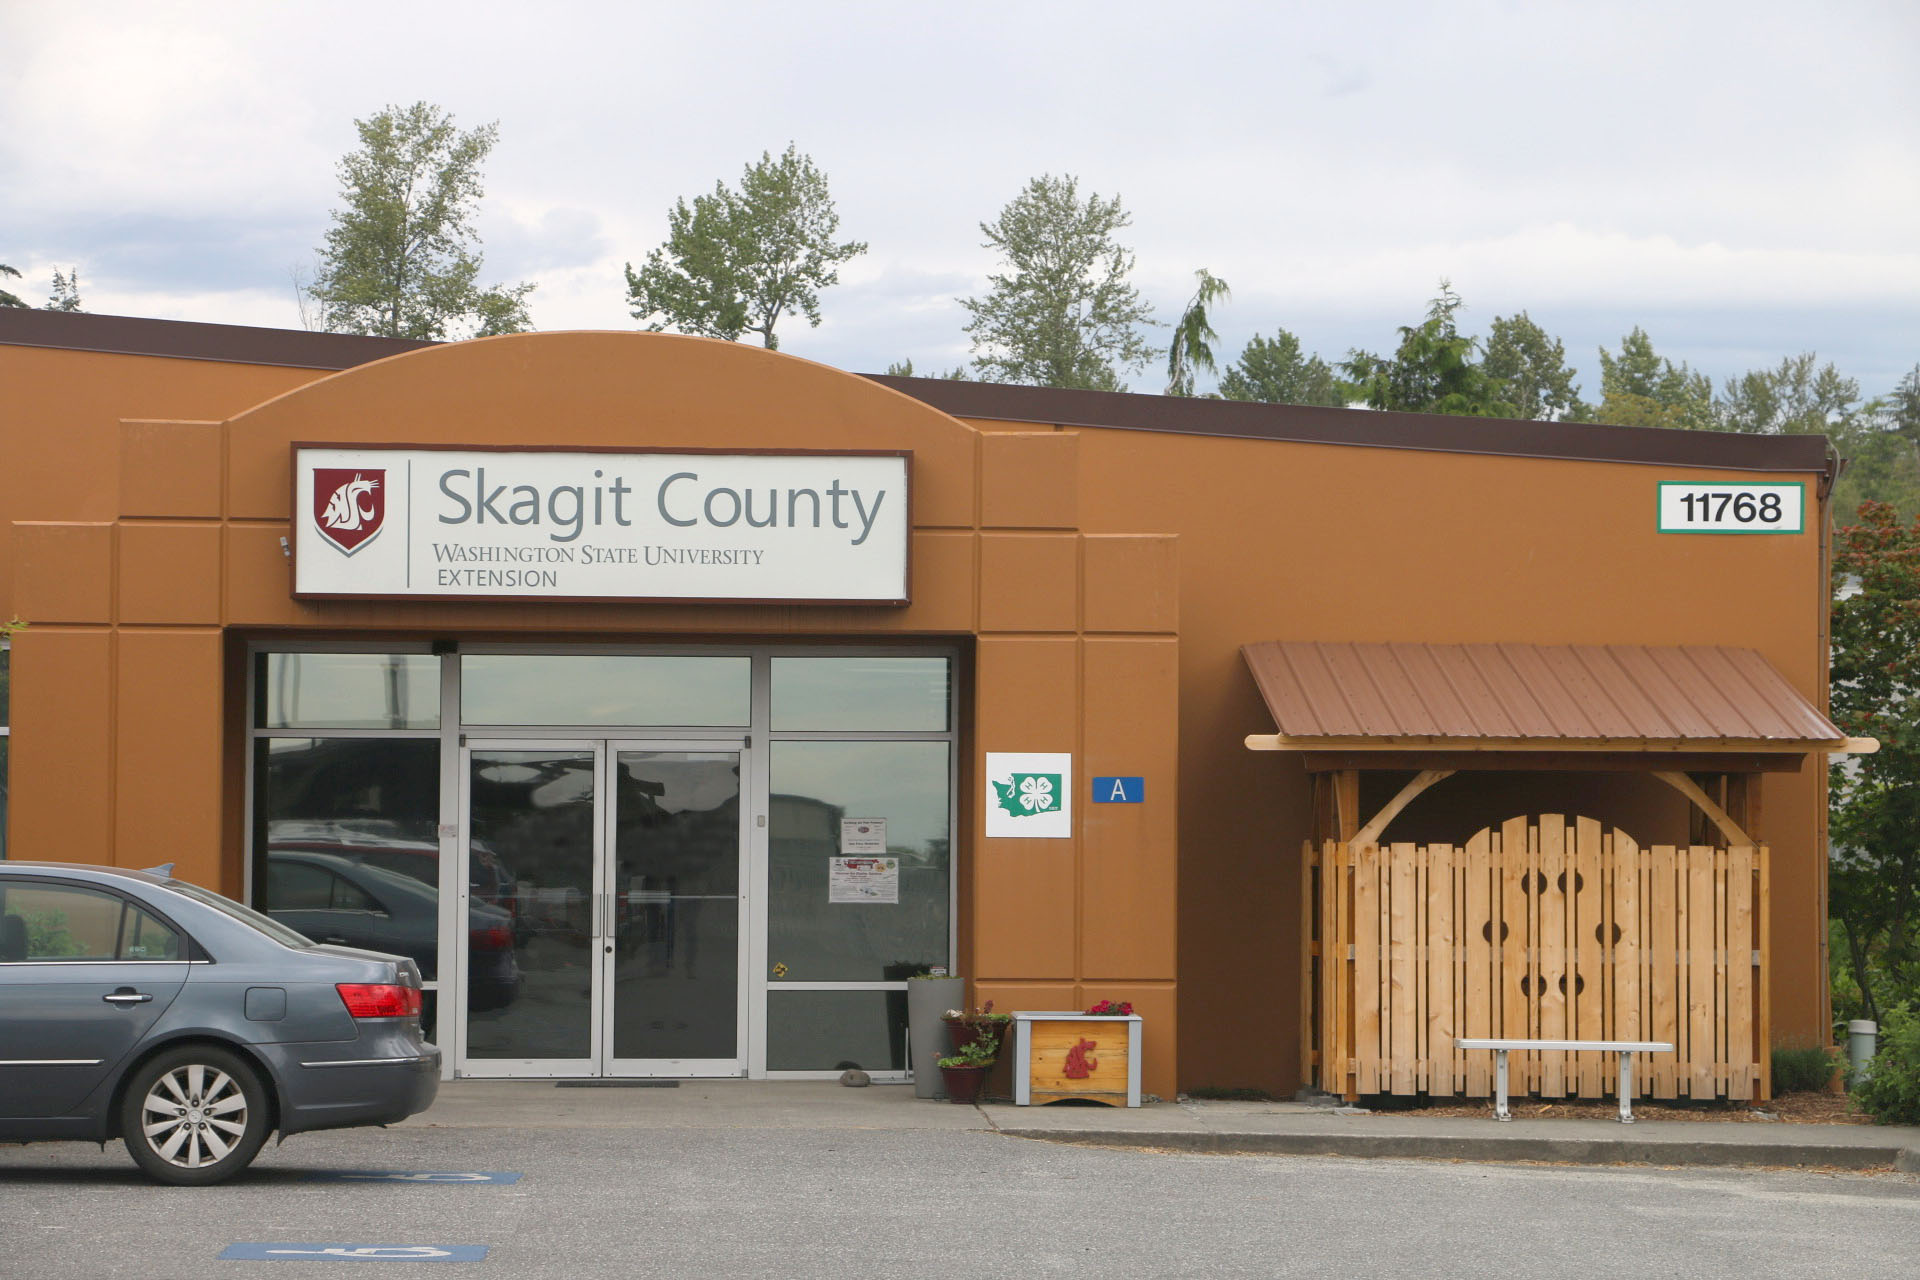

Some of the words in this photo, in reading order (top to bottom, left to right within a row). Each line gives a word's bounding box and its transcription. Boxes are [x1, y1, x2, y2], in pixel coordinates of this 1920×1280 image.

[437, 467, 632, 543] Skagit
[657, 471, 887, 546] County
[1680, 492, 1782, 523] 11768
[431, 543, 575, 563] WASHINGTON
[581, 544, 638, 565] STATE
[644, 545, 764, 566] UNIVERSITY
[437, 569, 557, 587] EXTENSION
[1024, 782, 1033, 790] H
[1040, 782, 1048, 790] H
[1110, 779, 1127, 801] A
[1024, 796, 1032, 805] H
[1040, 796, 1049, 805] H
